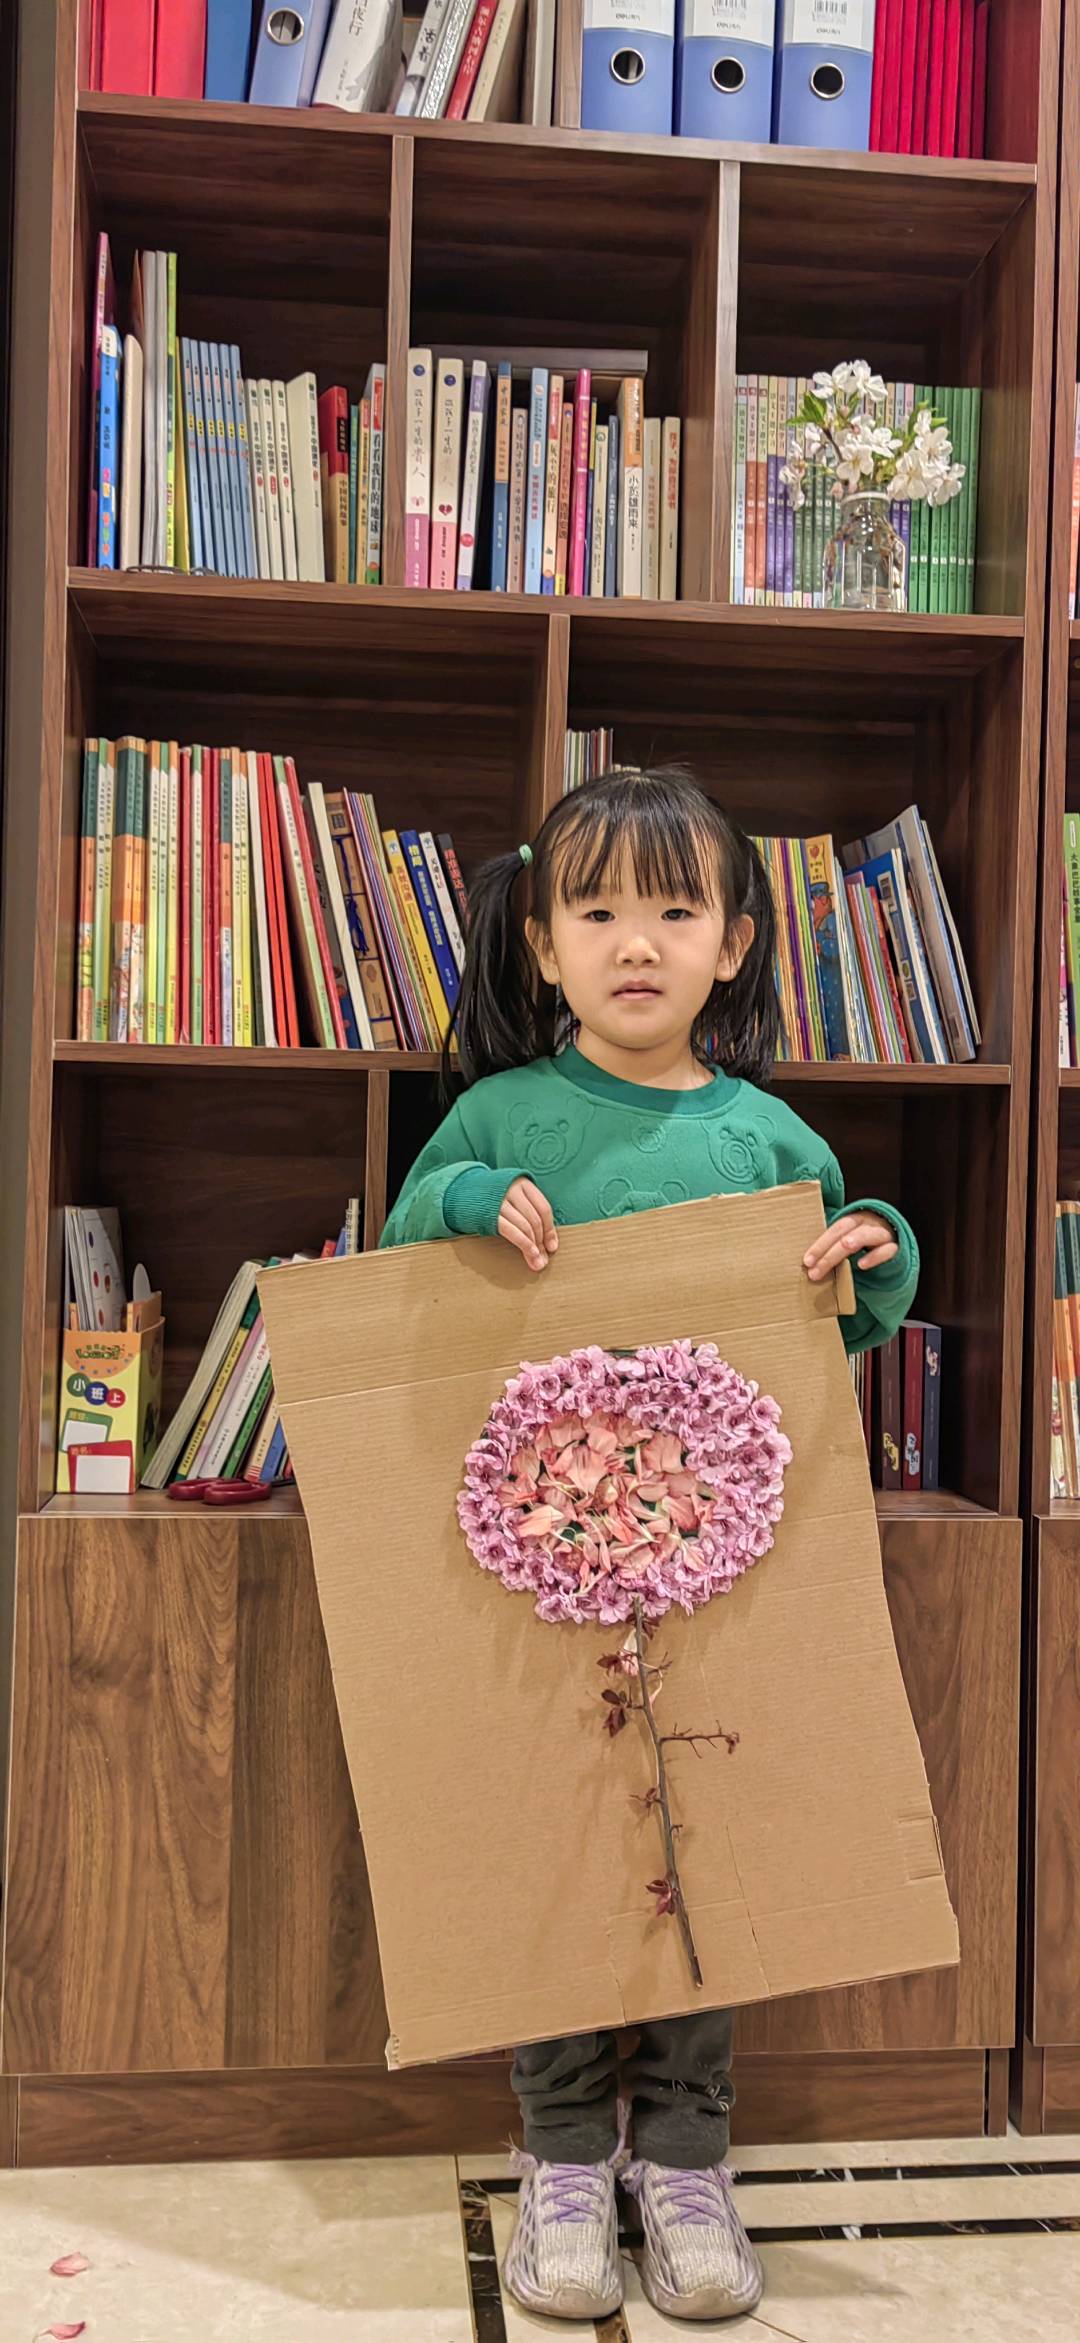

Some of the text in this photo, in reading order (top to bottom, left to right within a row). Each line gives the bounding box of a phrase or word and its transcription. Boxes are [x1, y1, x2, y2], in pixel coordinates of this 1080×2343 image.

[370, 432, 381, 534] 看看我们的地球
